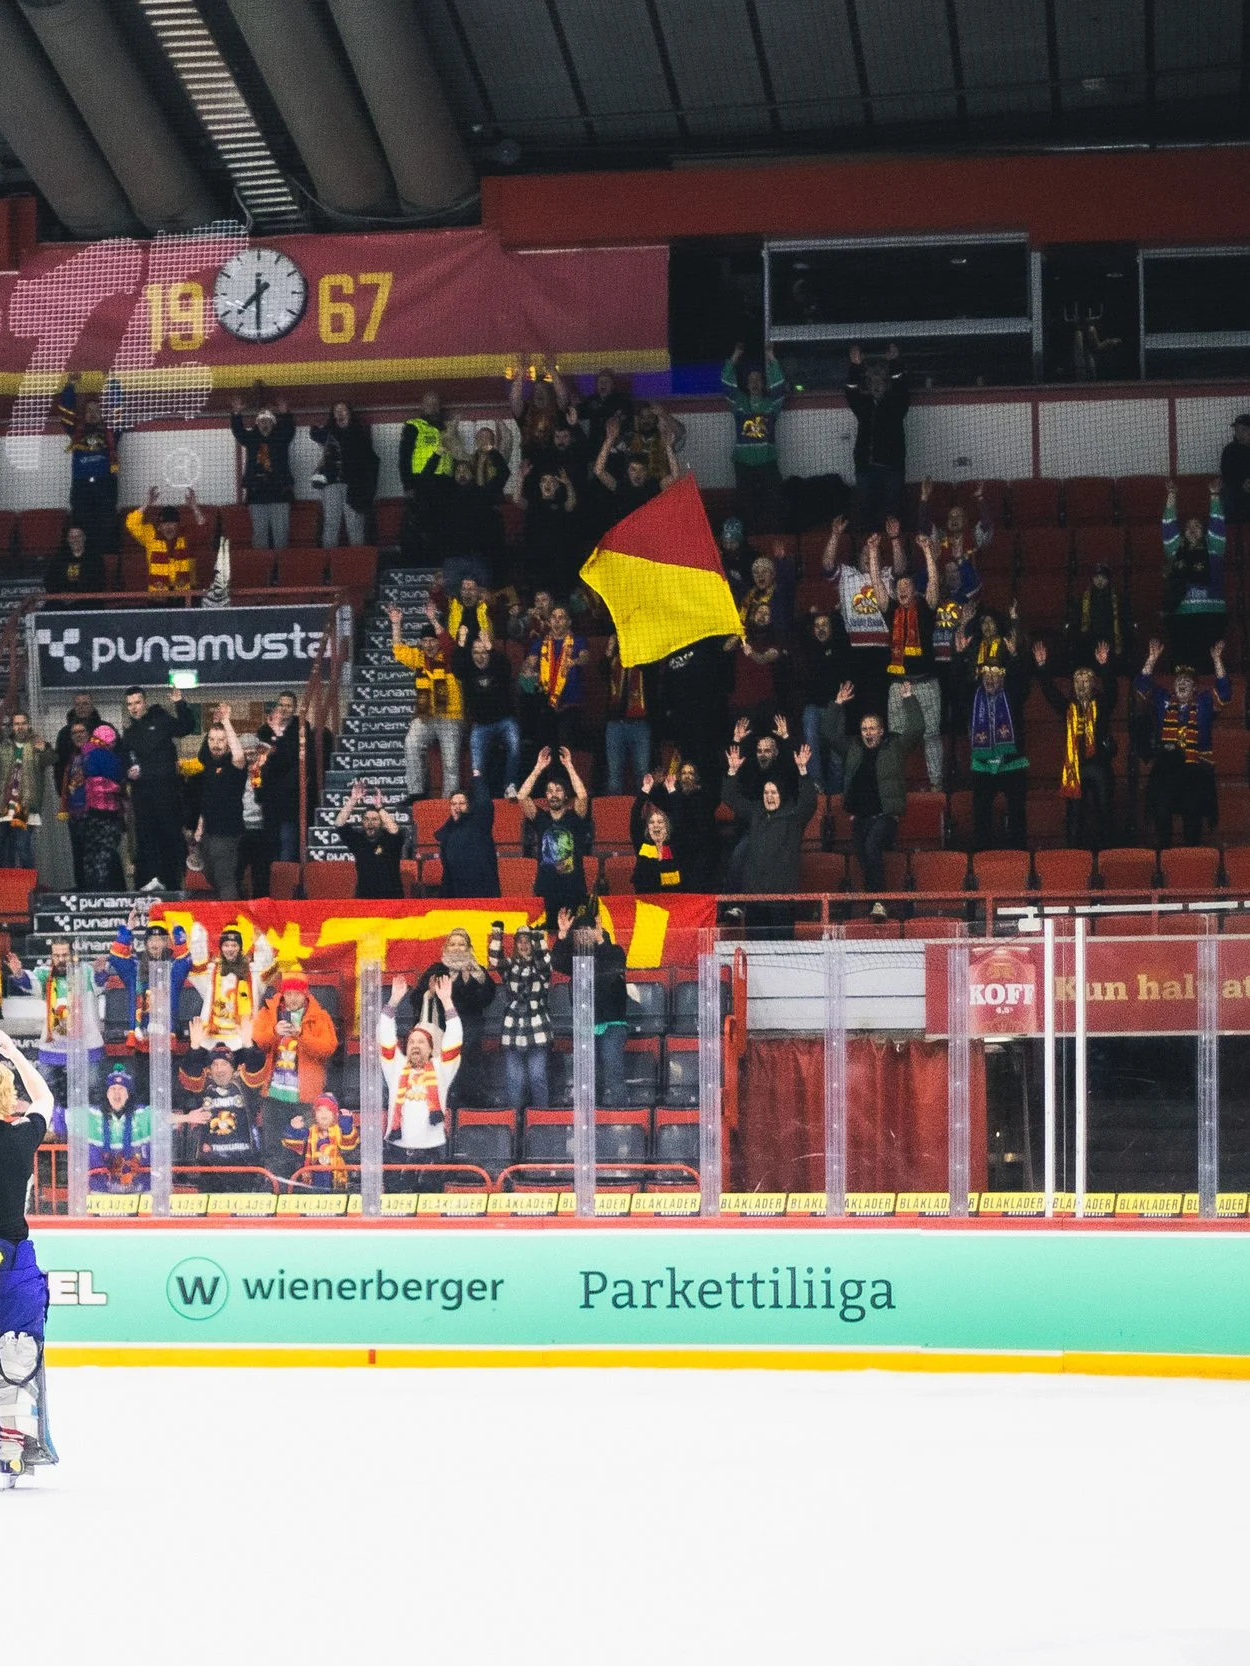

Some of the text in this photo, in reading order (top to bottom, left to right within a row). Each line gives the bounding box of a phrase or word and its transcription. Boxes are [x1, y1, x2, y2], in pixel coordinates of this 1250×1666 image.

[145, 272, 393, 352] 19 67
[91, 621, 333, 672] punamusta
[969, 983, 1035, 1005] KOFF
[1054, 976, 1129, 1001] Kun
[242, 1268, 505, 1312] wienerberger
[579, 1266, 896, 1323] Parkettiliiga
